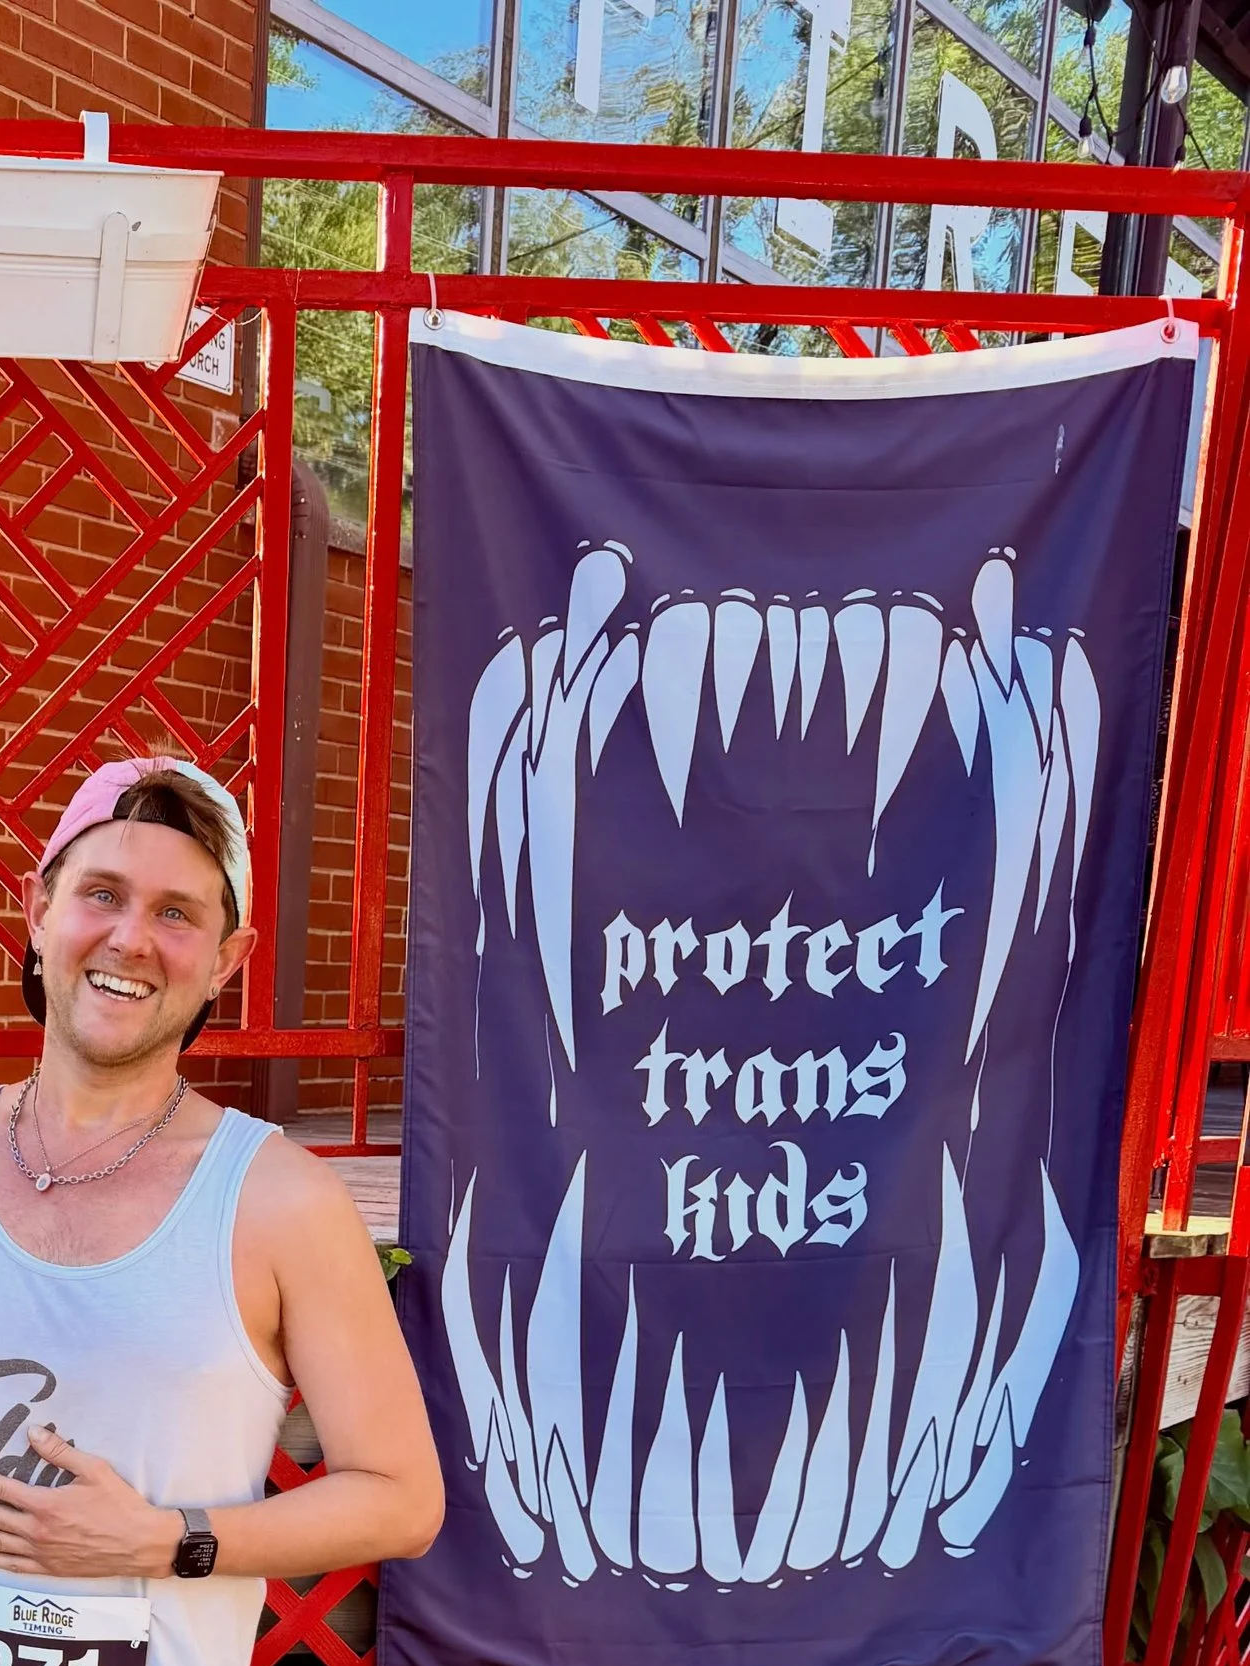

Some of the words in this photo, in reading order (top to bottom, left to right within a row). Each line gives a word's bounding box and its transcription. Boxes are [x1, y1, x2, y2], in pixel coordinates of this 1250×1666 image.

[601, 877, 965, 1016] protect
[634, 1017, 907, 1127] trans
[661, 1141, 867, 1261] kids
[22, 1622, 63, 1635] TIMING
